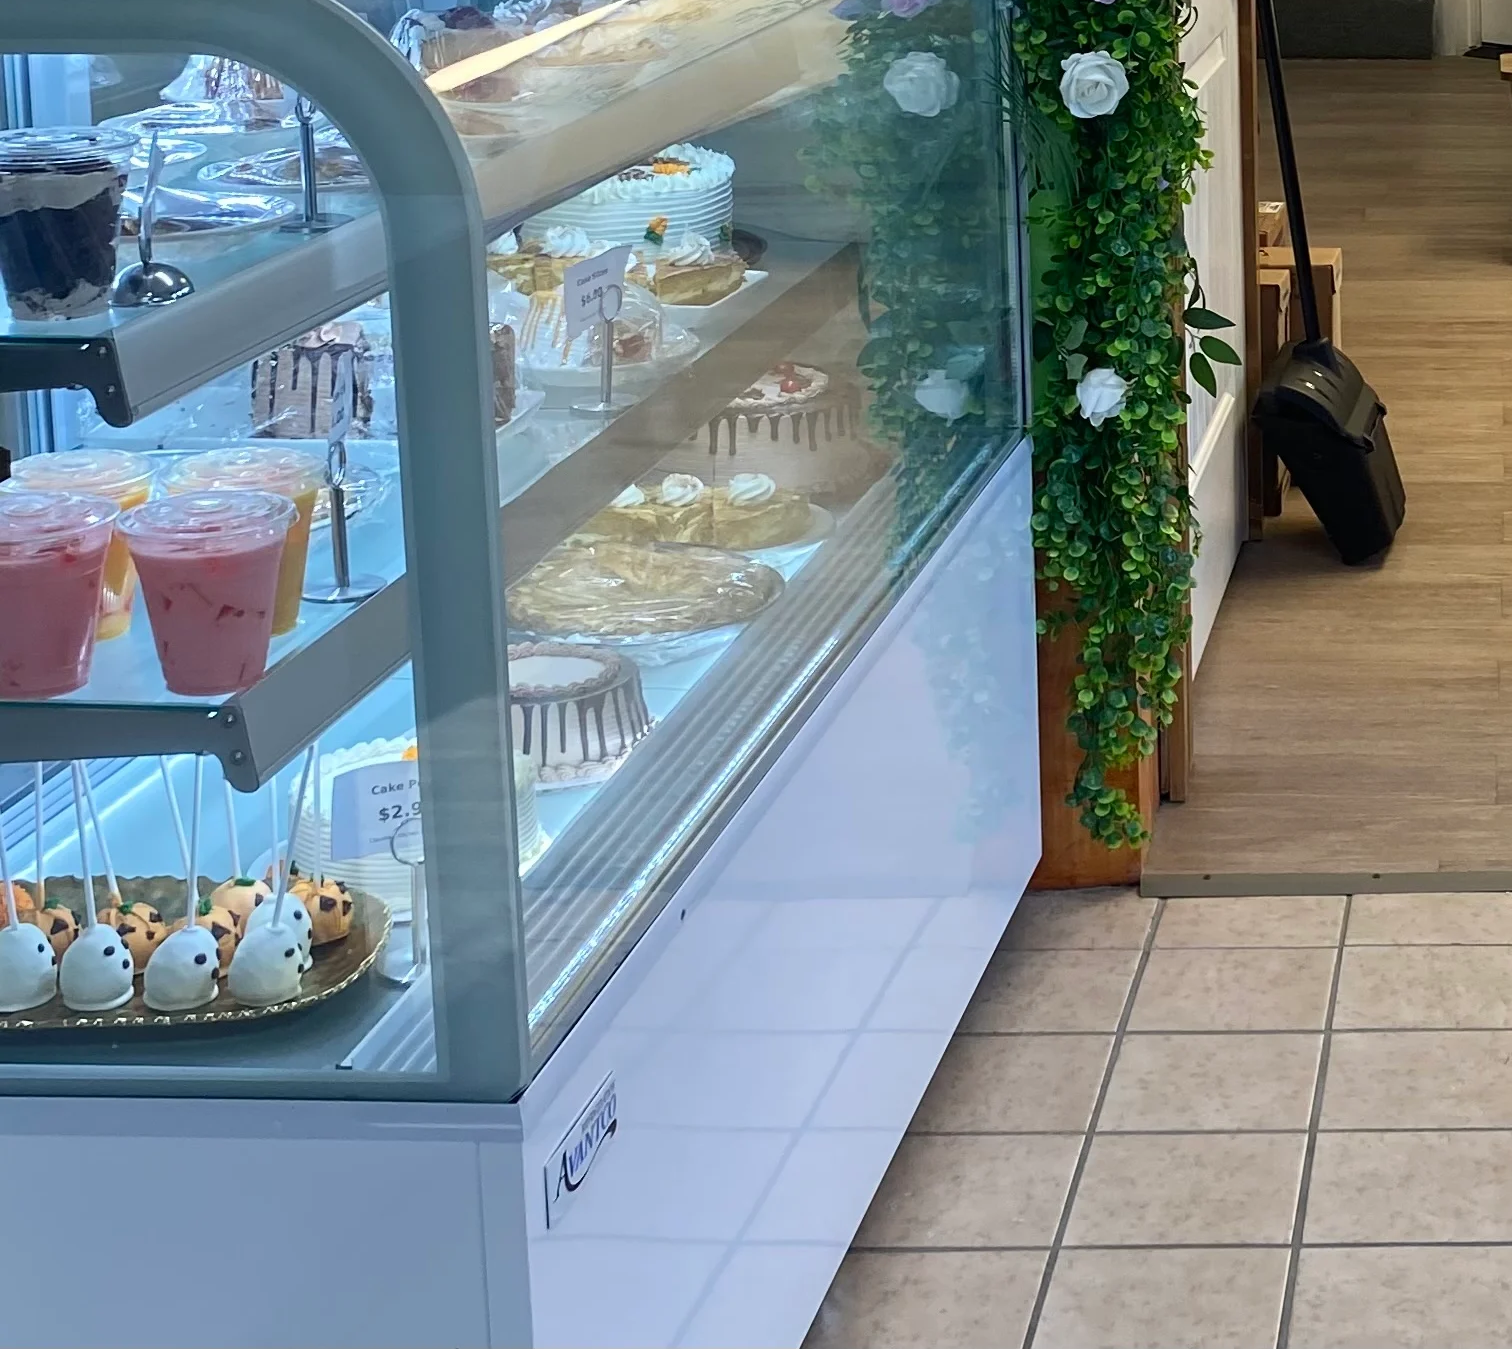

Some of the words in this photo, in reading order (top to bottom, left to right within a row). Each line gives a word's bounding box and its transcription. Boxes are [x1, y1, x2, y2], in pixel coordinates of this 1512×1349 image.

[371, 782, 404, 795] Cake
[408, 779, 420, 790] P
[553, 1093, 617, 1204] AVANTCO
